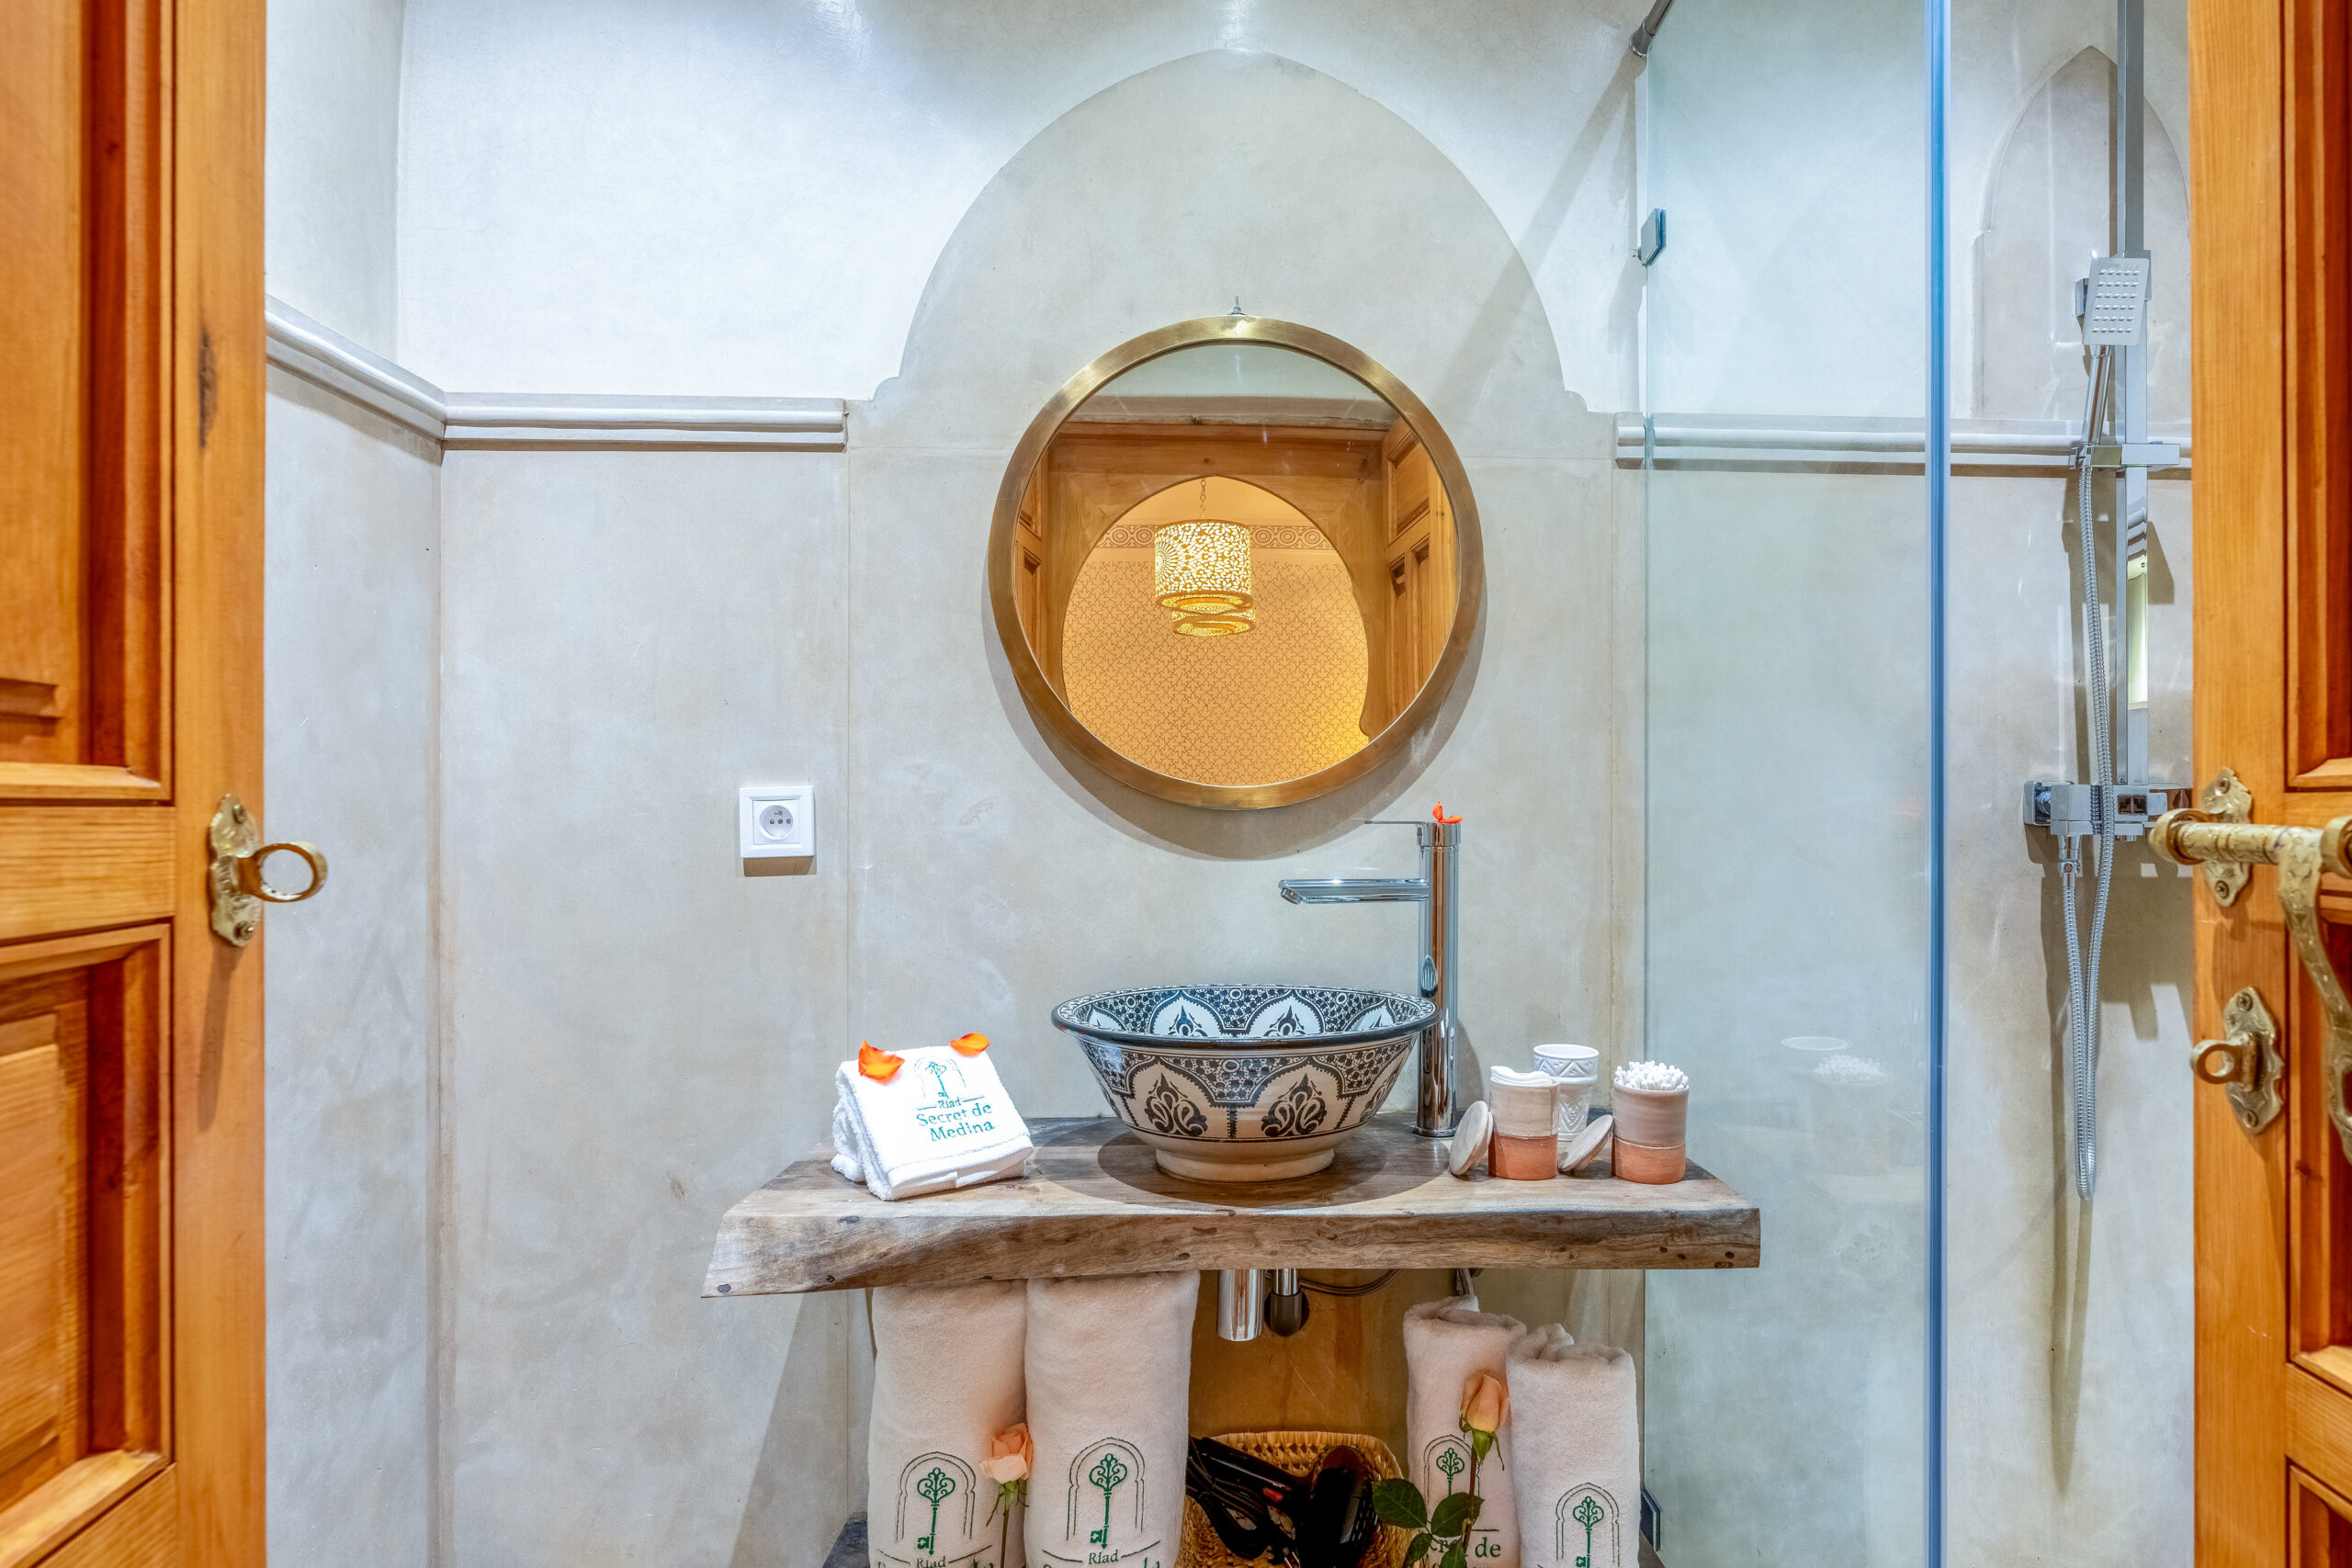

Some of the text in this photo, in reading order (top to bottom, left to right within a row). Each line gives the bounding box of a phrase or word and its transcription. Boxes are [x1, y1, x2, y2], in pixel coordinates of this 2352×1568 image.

[937, 1096, 962, 1109] Riad
[916, 1102, 992, 1127] Secret de
[930, 1121, 995, 1142] Medina
[1475, 1536, 1501, 1559] de
[916, 1555, 946, 1568] Riad
[1088, 1549, 1119, 1565] Riad
